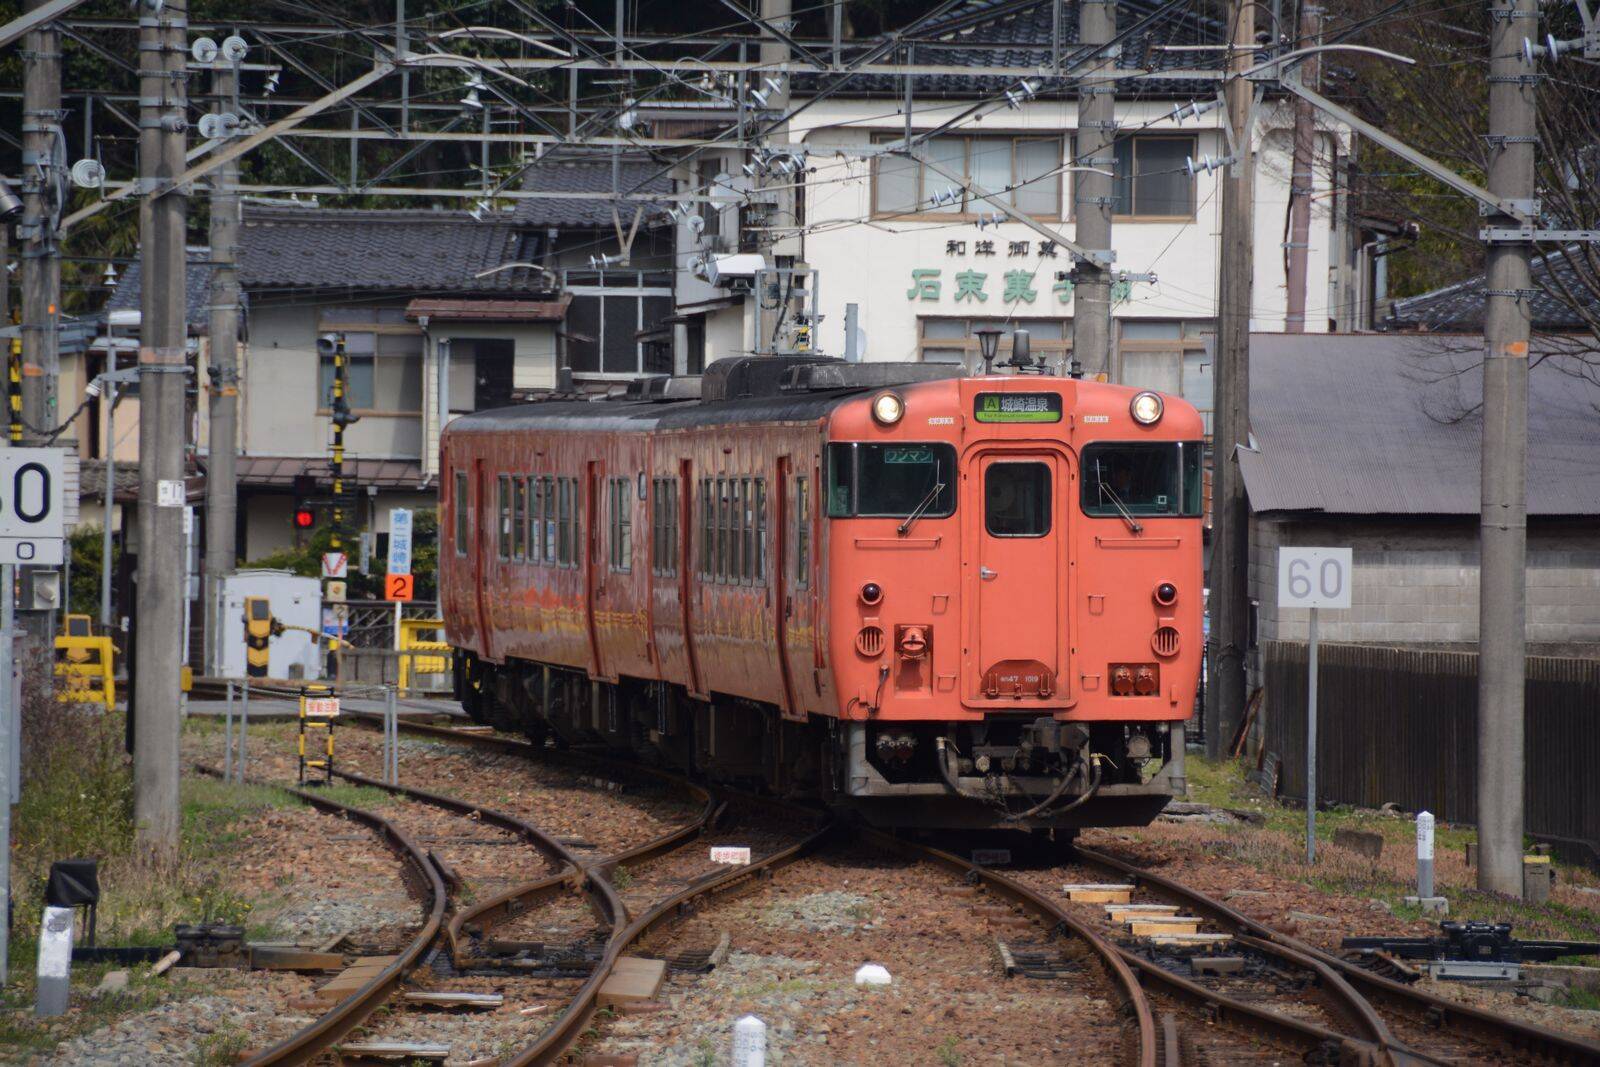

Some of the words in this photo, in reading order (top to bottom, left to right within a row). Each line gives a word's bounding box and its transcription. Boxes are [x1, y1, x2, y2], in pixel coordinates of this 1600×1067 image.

[0, 462, 51, 523] 0
[393, 577, 407, 597] 2
[1288, 558, 1342, 599] 60
